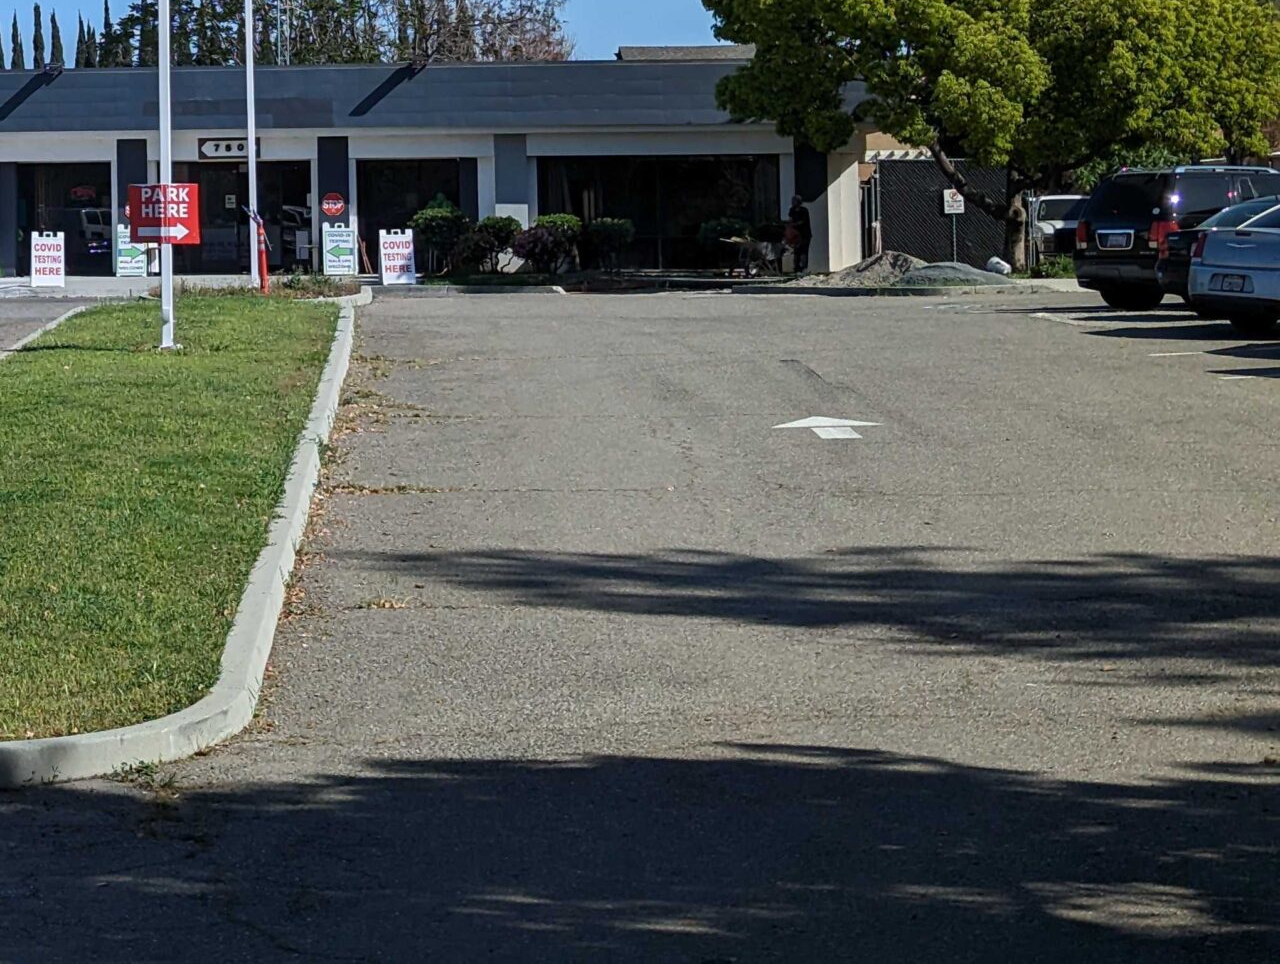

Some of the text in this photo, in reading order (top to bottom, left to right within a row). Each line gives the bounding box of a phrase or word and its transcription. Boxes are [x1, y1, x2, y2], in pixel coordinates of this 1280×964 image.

[141, 187, 190, 202] PARK
[322, 199, 344, 209] STOP
[141, 204, 189, 218] HERE
[34, 243, 62, 252] COVID
[382, 240, 411, 250] COVID
[34, 255, 62, 264] TESTING
[383, 252, 412, 261] TESTING
[34, 267, 62, 276] HERE
[384, 264, 413, 273] HERE
